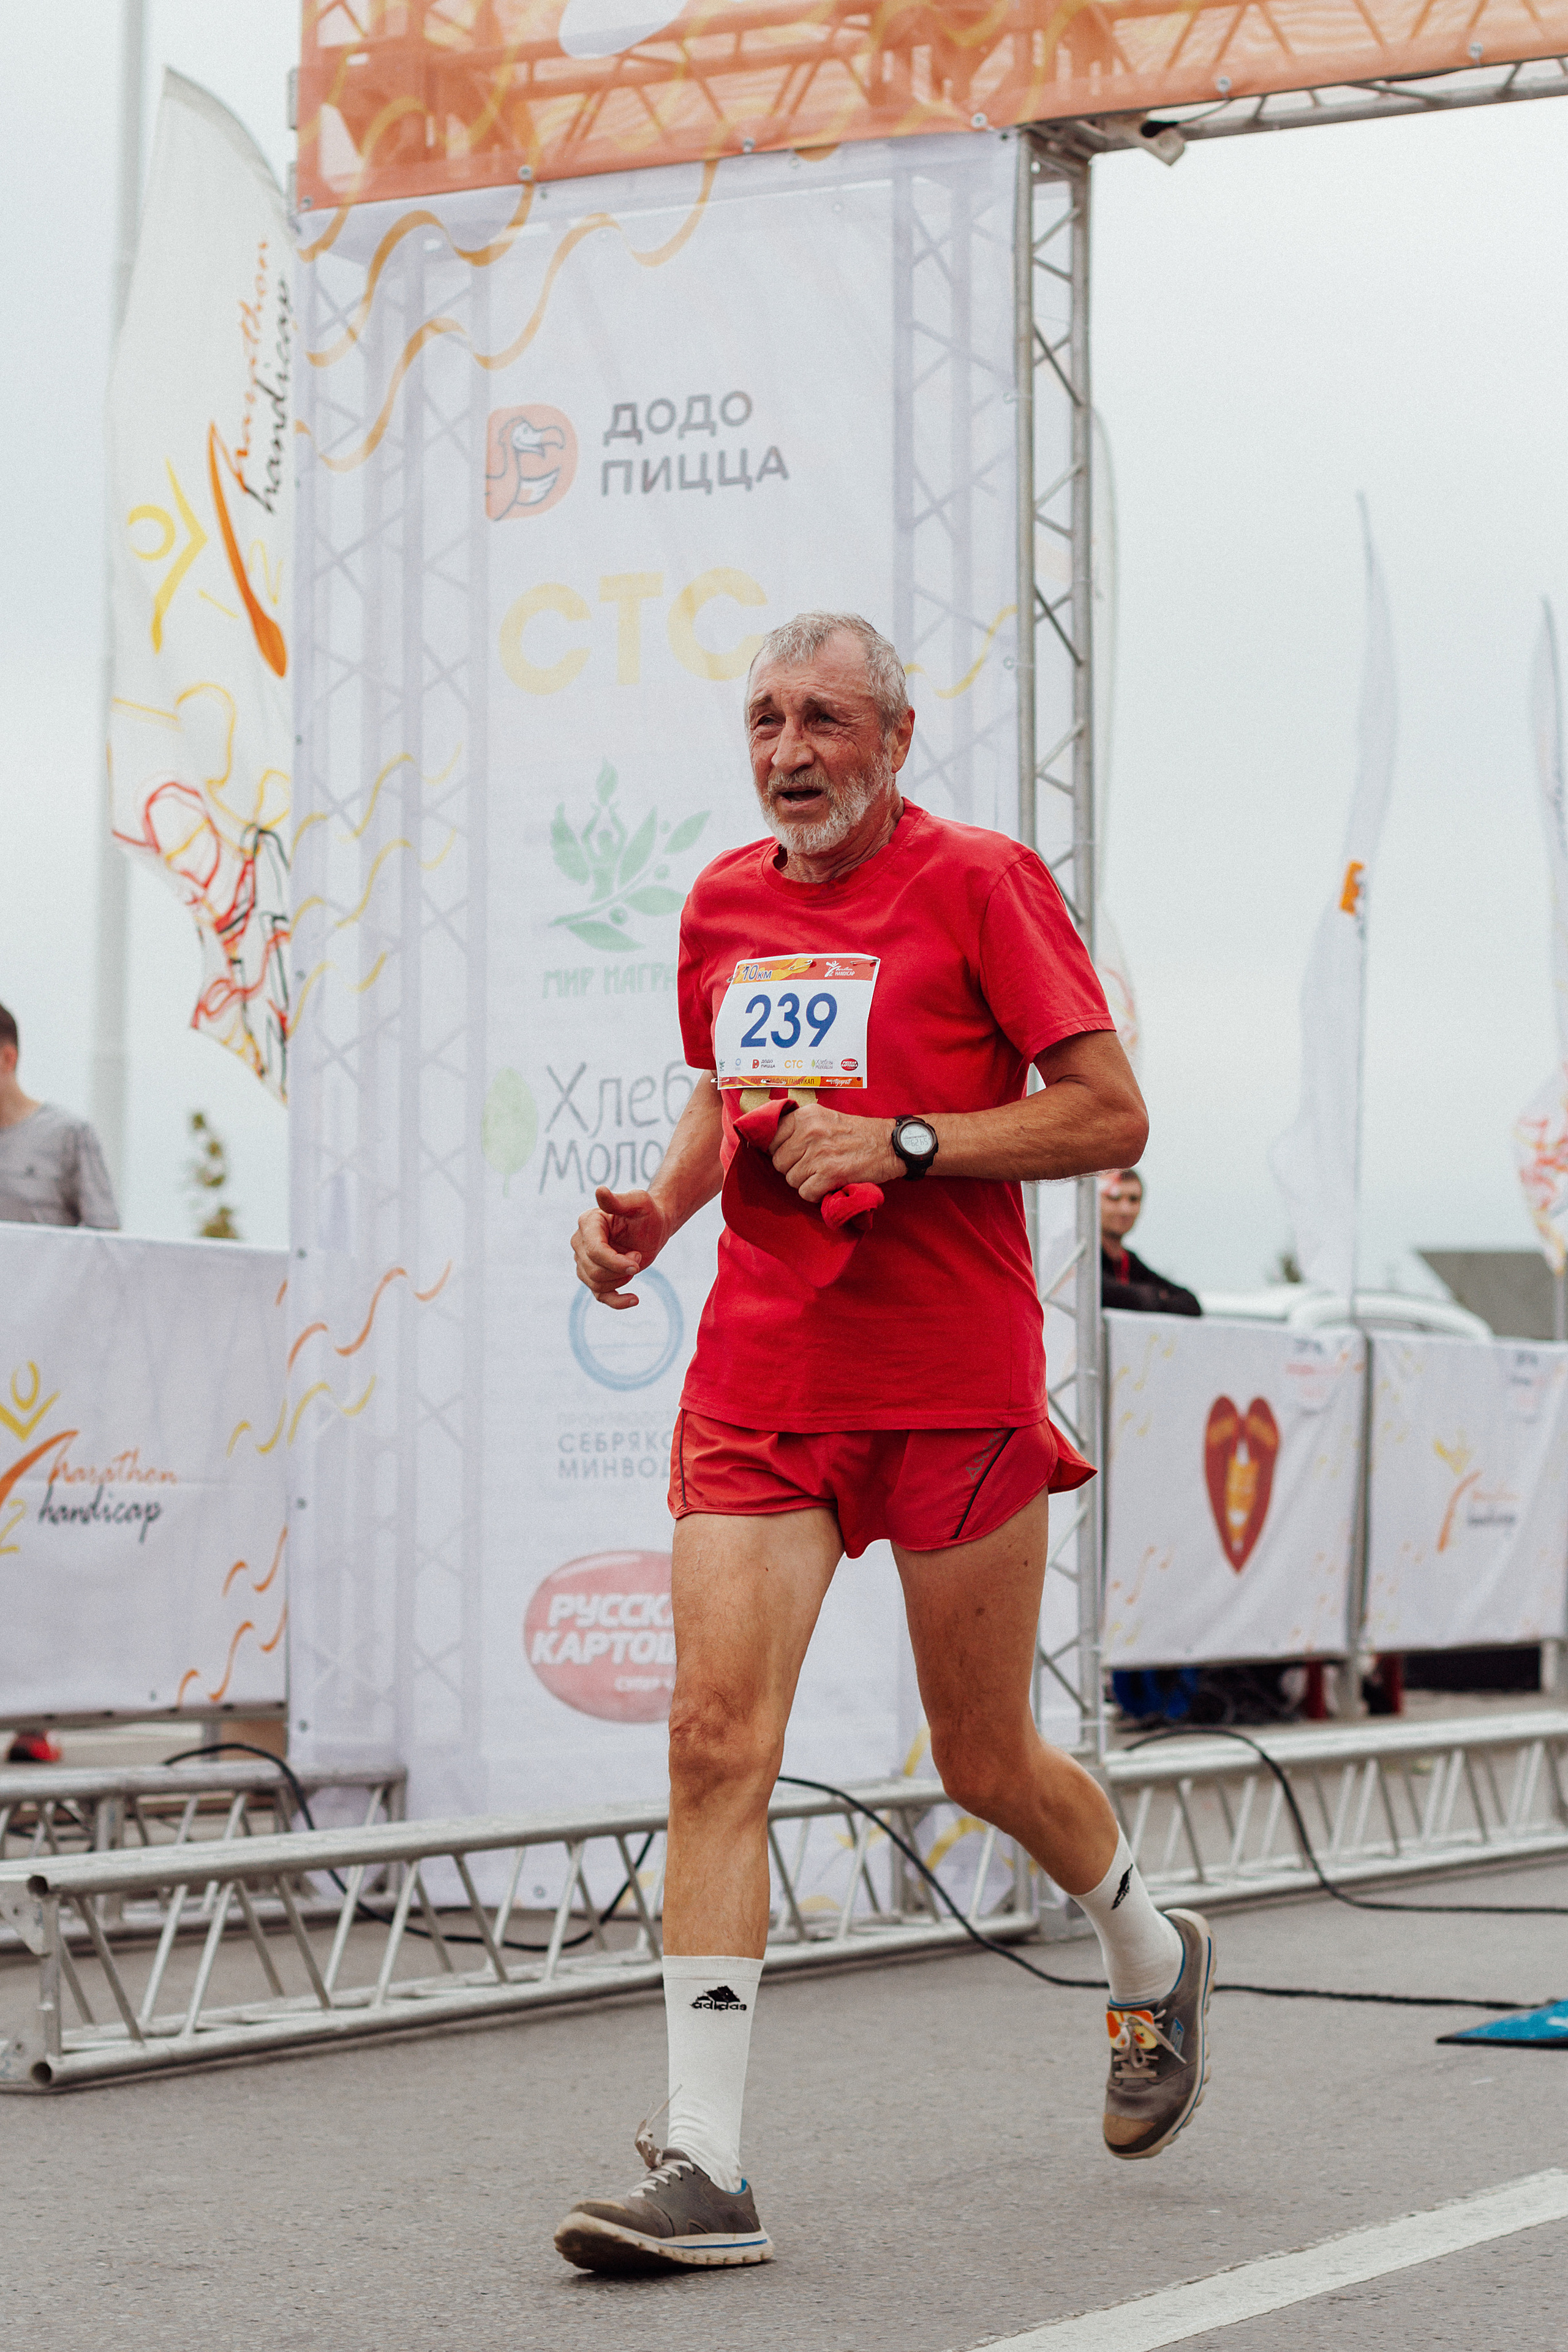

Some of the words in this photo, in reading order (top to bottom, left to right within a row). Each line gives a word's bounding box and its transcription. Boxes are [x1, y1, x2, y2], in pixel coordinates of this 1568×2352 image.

[602, 390, 753, 447] ДОДО
[601, 446, 790, 497] ПИЦЦА
[498, 567, 769, 696] СТС
[542, 966, 595, 1000] МИР
[604, 962, 677, 995] НАГРА
[740, 992, 838, 1049] 239
[784, 1060, 803, 1069] СТС
[545, 1061, 695, 1138] Хлеб
[538, 1139, 665, 1194] Моло
[557, 1430, 673, 1453] СЕБРЯКО
[558, 1455, 671, 1480] МИНВОД
[37, 1484, 162, 1544] handicap
[547, 1593, 673, 1629] РУССК
[691, 2000, 747, 2011] adidas
